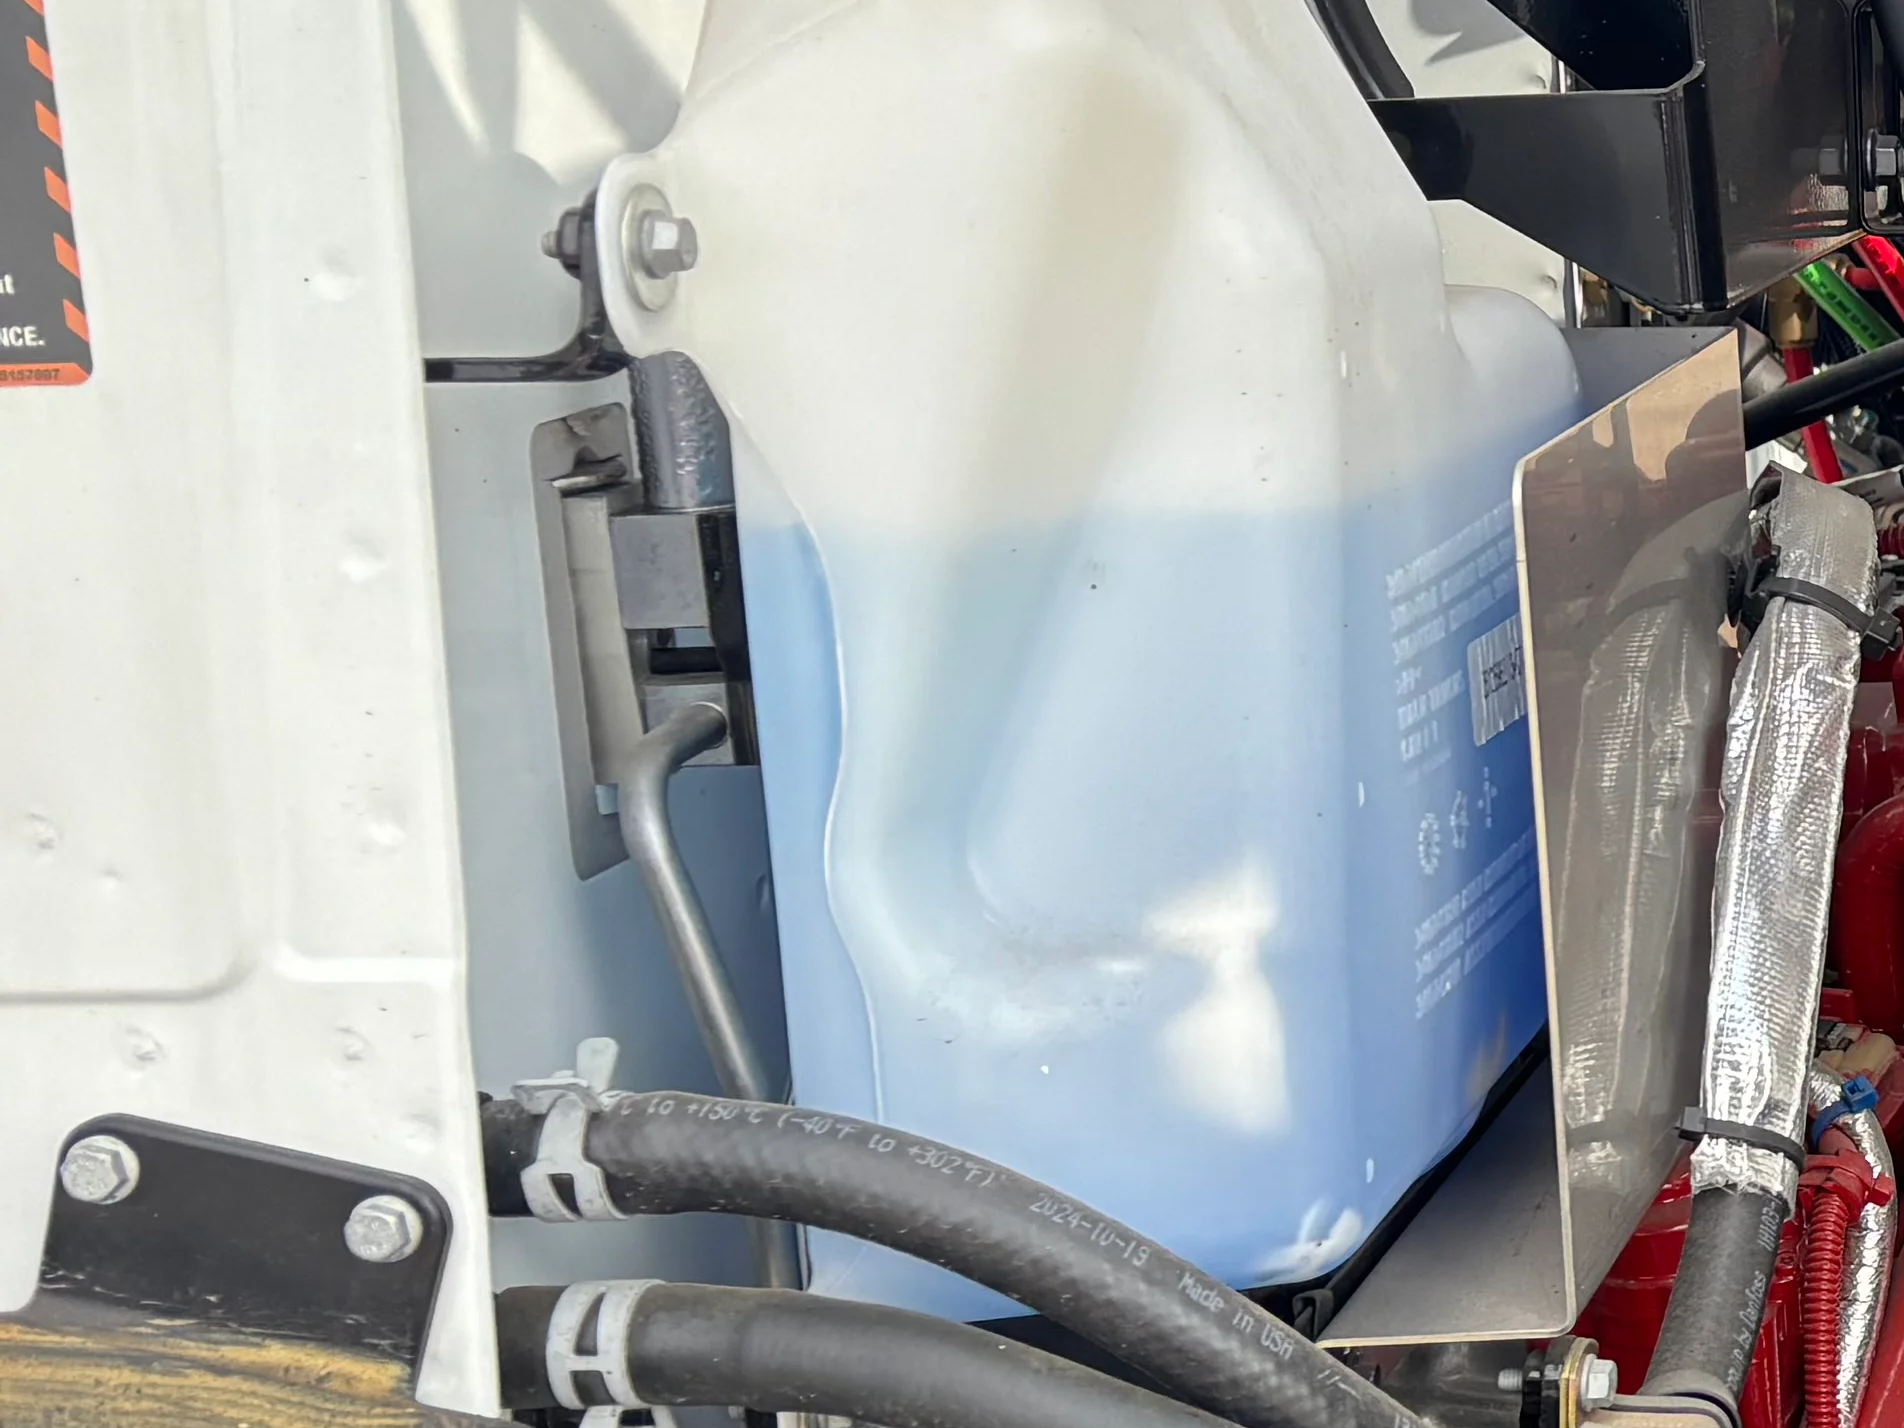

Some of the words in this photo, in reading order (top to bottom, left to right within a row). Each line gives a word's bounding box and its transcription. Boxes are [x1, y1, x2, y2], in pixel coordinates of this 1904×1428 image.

[1177, 1271, 1225, 1312] Made
[1232, 1311, 1254, 1334] in
[1260, 1327, 1295, 1360] USA
